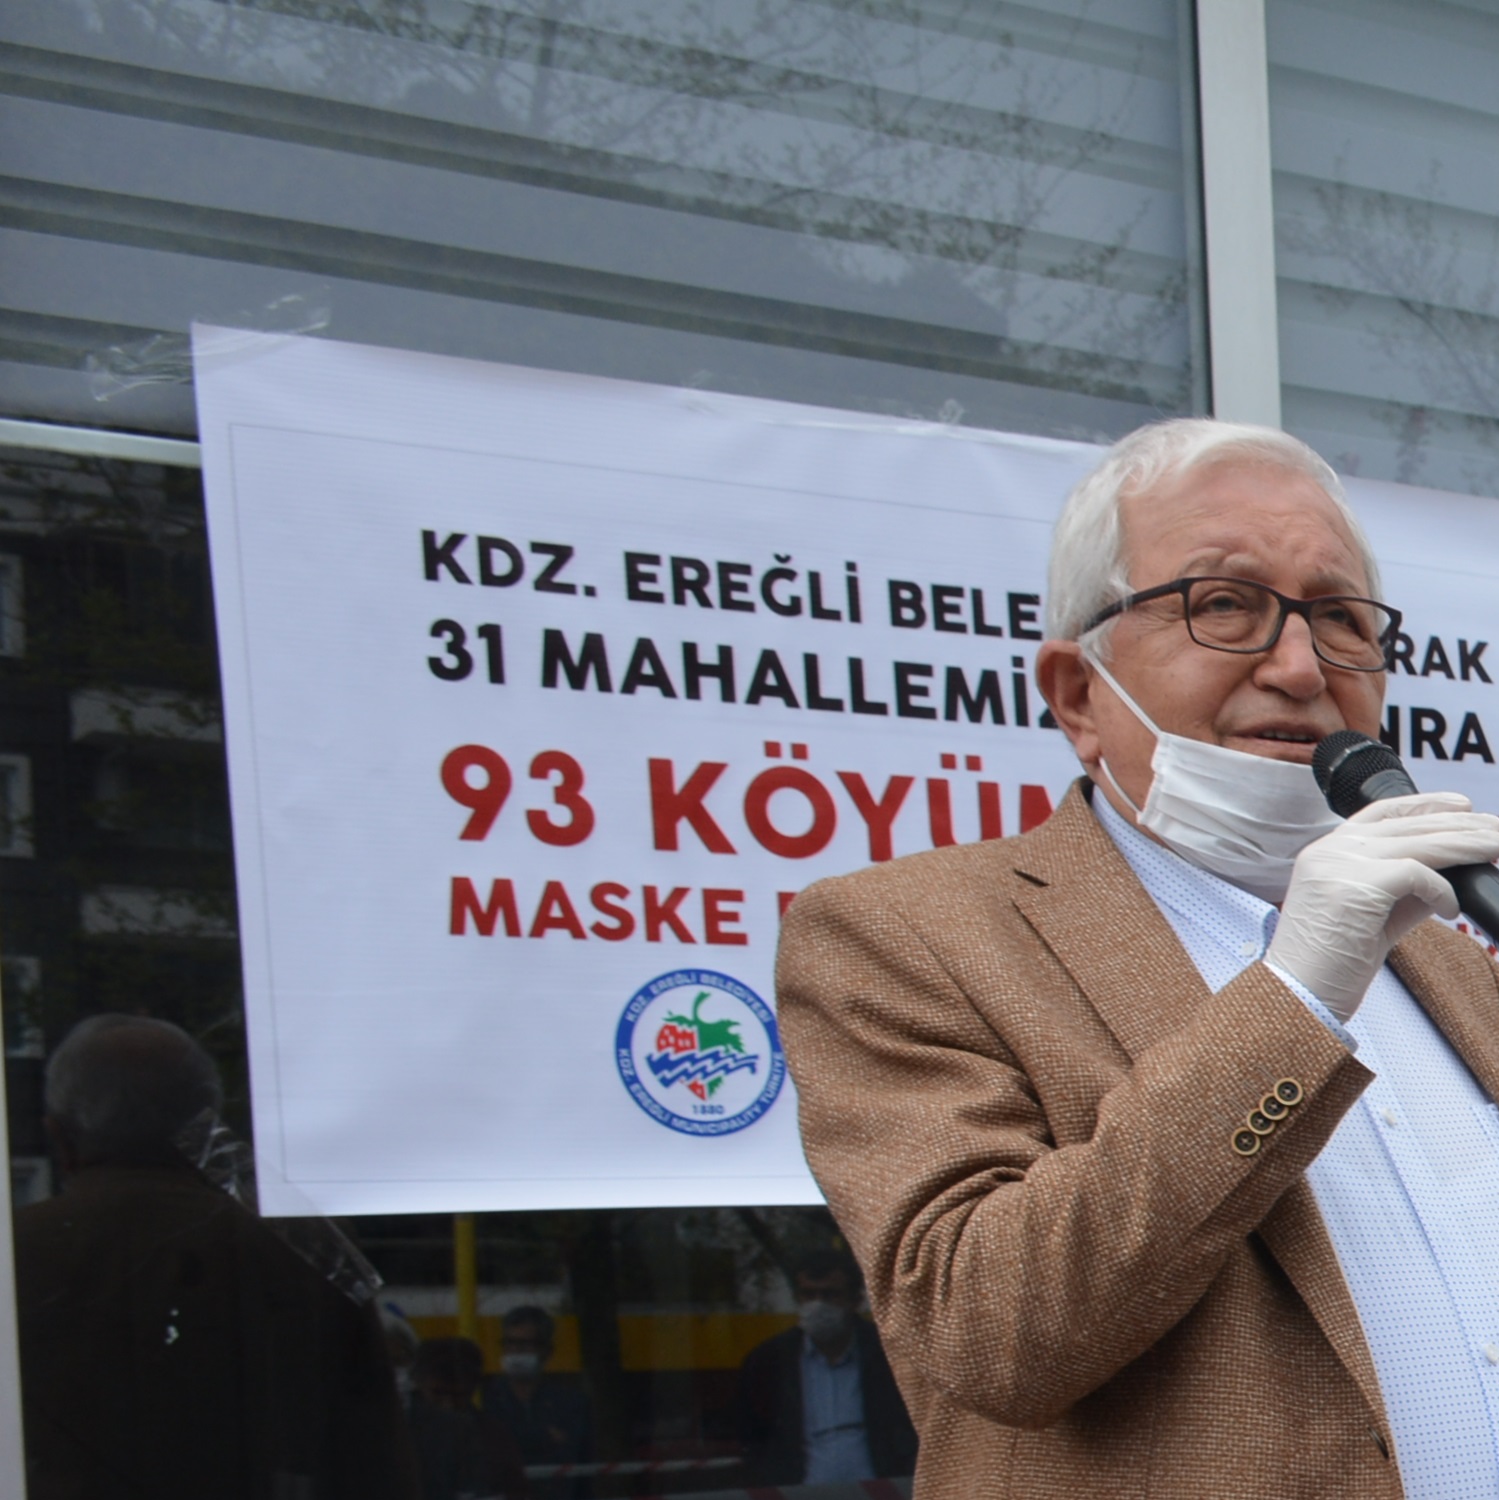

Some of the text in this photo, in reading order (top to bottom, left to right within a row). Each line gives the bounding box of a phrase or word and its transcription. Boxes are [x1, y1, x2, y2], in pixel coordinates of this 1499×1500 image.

[420, 528, 1494, 685] KDZ. EREĞLİ BELE RAK
[427, 618, 505, 686] 31
[1379, 703, 1495, 765] NRA
[439, 744, 596, 848] 93
[449, 875, 749, 946] MASKE
